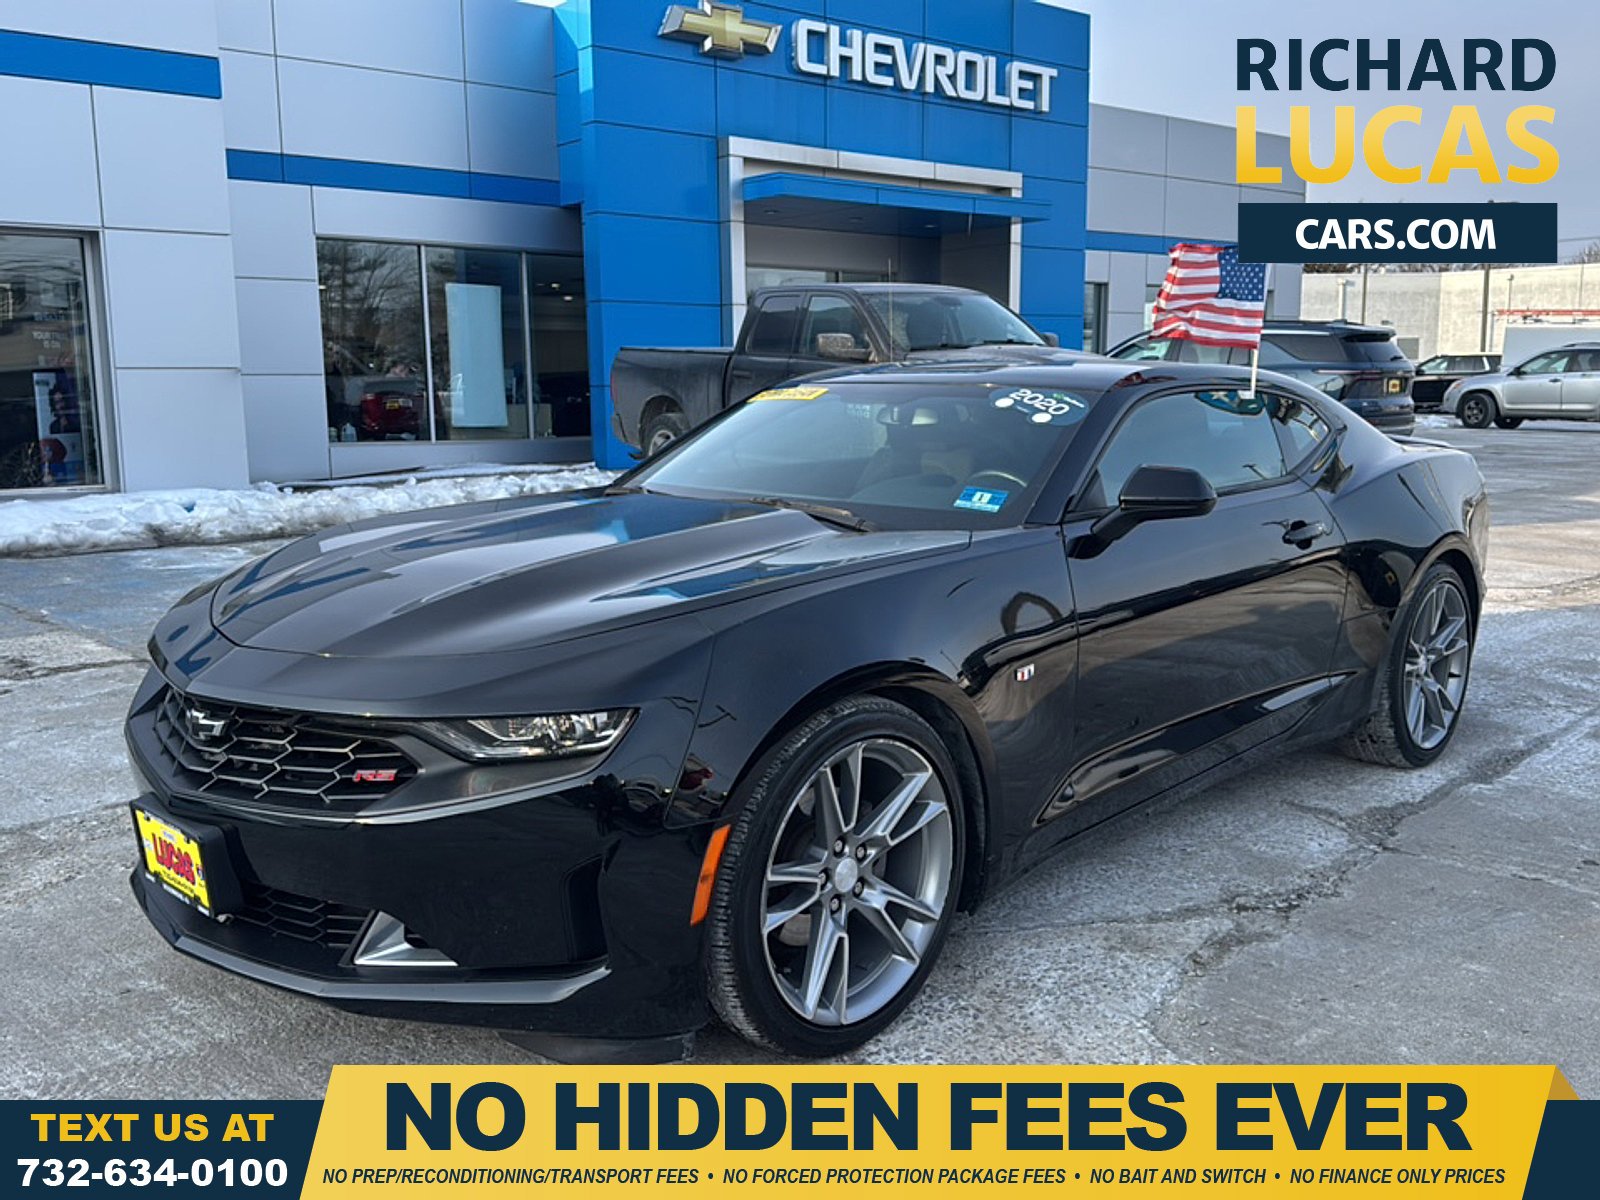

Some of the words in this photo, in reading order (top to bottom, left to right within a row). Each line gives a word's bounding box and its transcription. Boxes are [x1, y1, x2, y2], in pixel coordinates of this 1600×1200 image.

[792, 19, 1058, 113] CHEVROLET
[1009, 388, 1070, 415] 2020
[352, 769, 397, 782] RS
[151, 832, 196, 886] LUCAS
